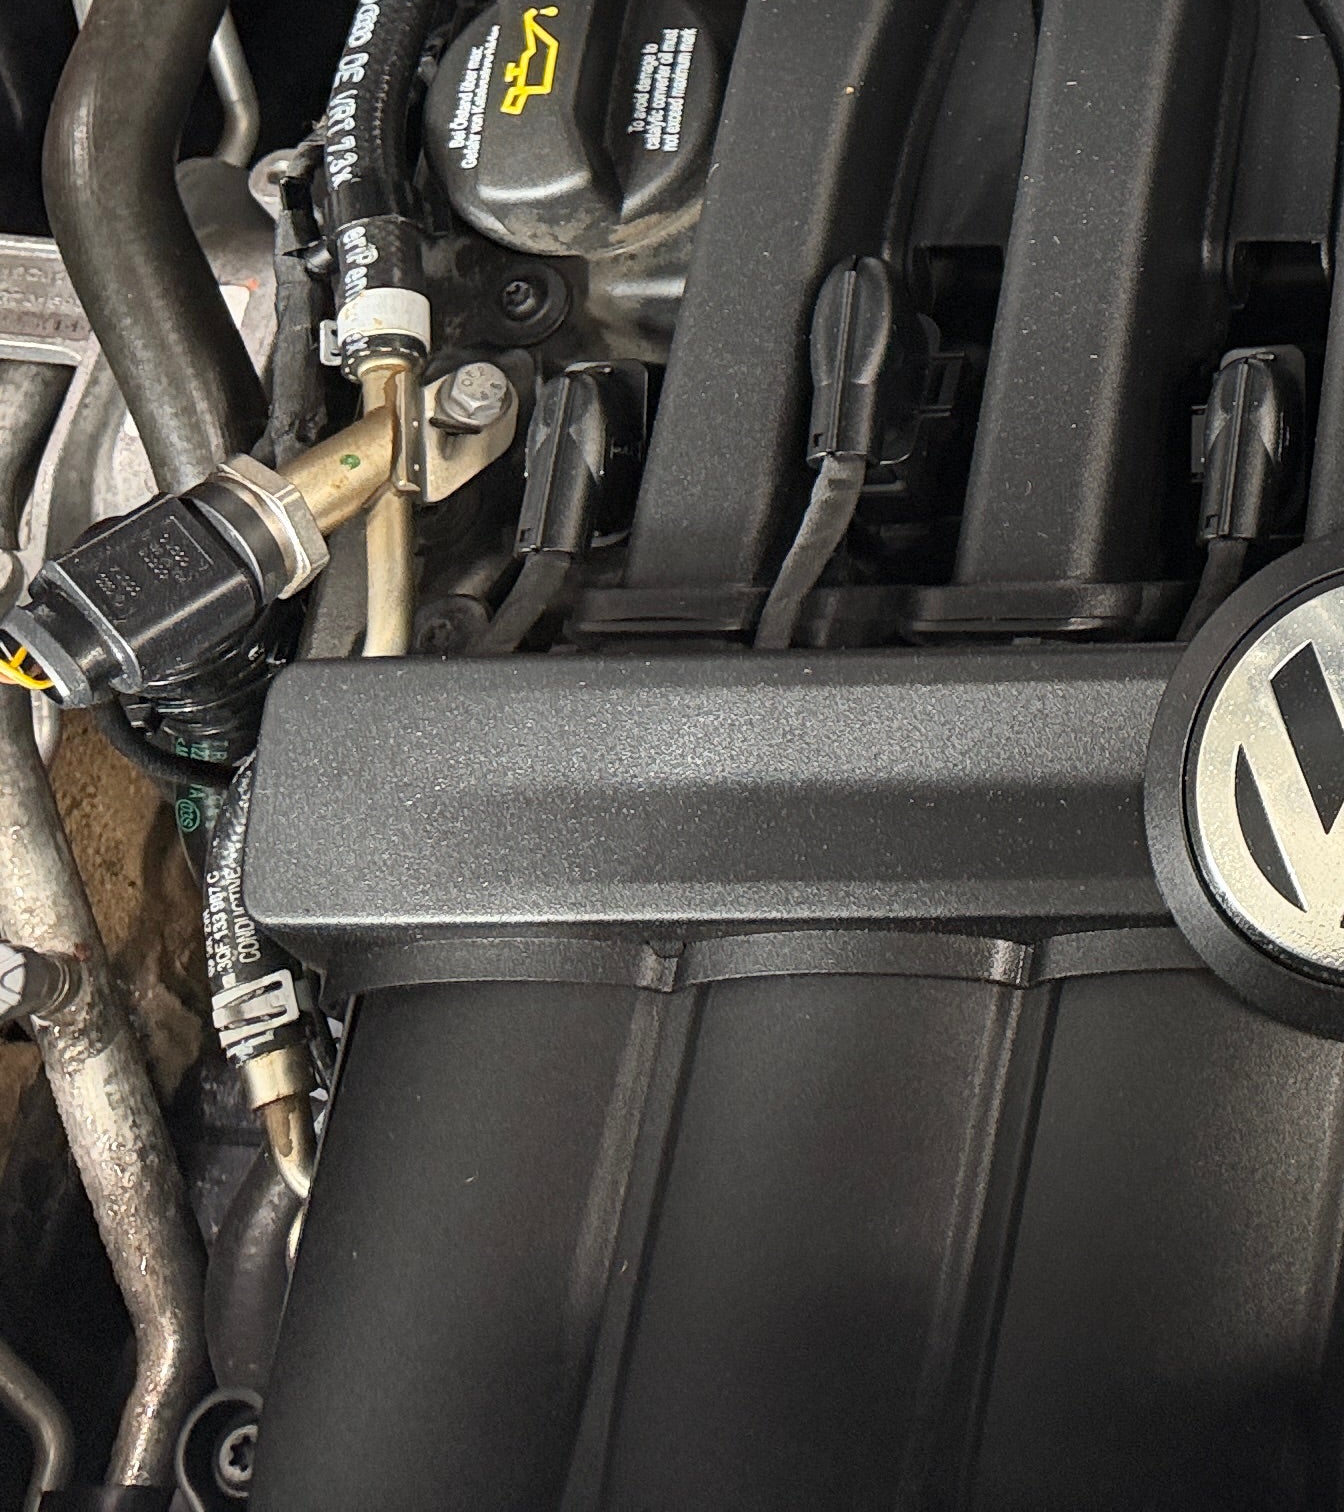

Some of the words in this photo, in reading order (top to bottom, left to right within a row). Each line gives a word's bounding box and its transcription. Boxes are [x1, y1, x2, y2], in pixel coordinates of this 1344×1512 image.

[678, 27, 698, 51] mark
[634, 53, 658, 91] damage
[650, 63, 672, 108] converter
[669, 51, 692, 97] maximum
[326, 89, 358, 138] VRT
[633, 92, 649, 119] avoid
[665, 96, 684, 133] exceed
[662, 133, 679, 151] not
[211, 911, 229, 940] 133
